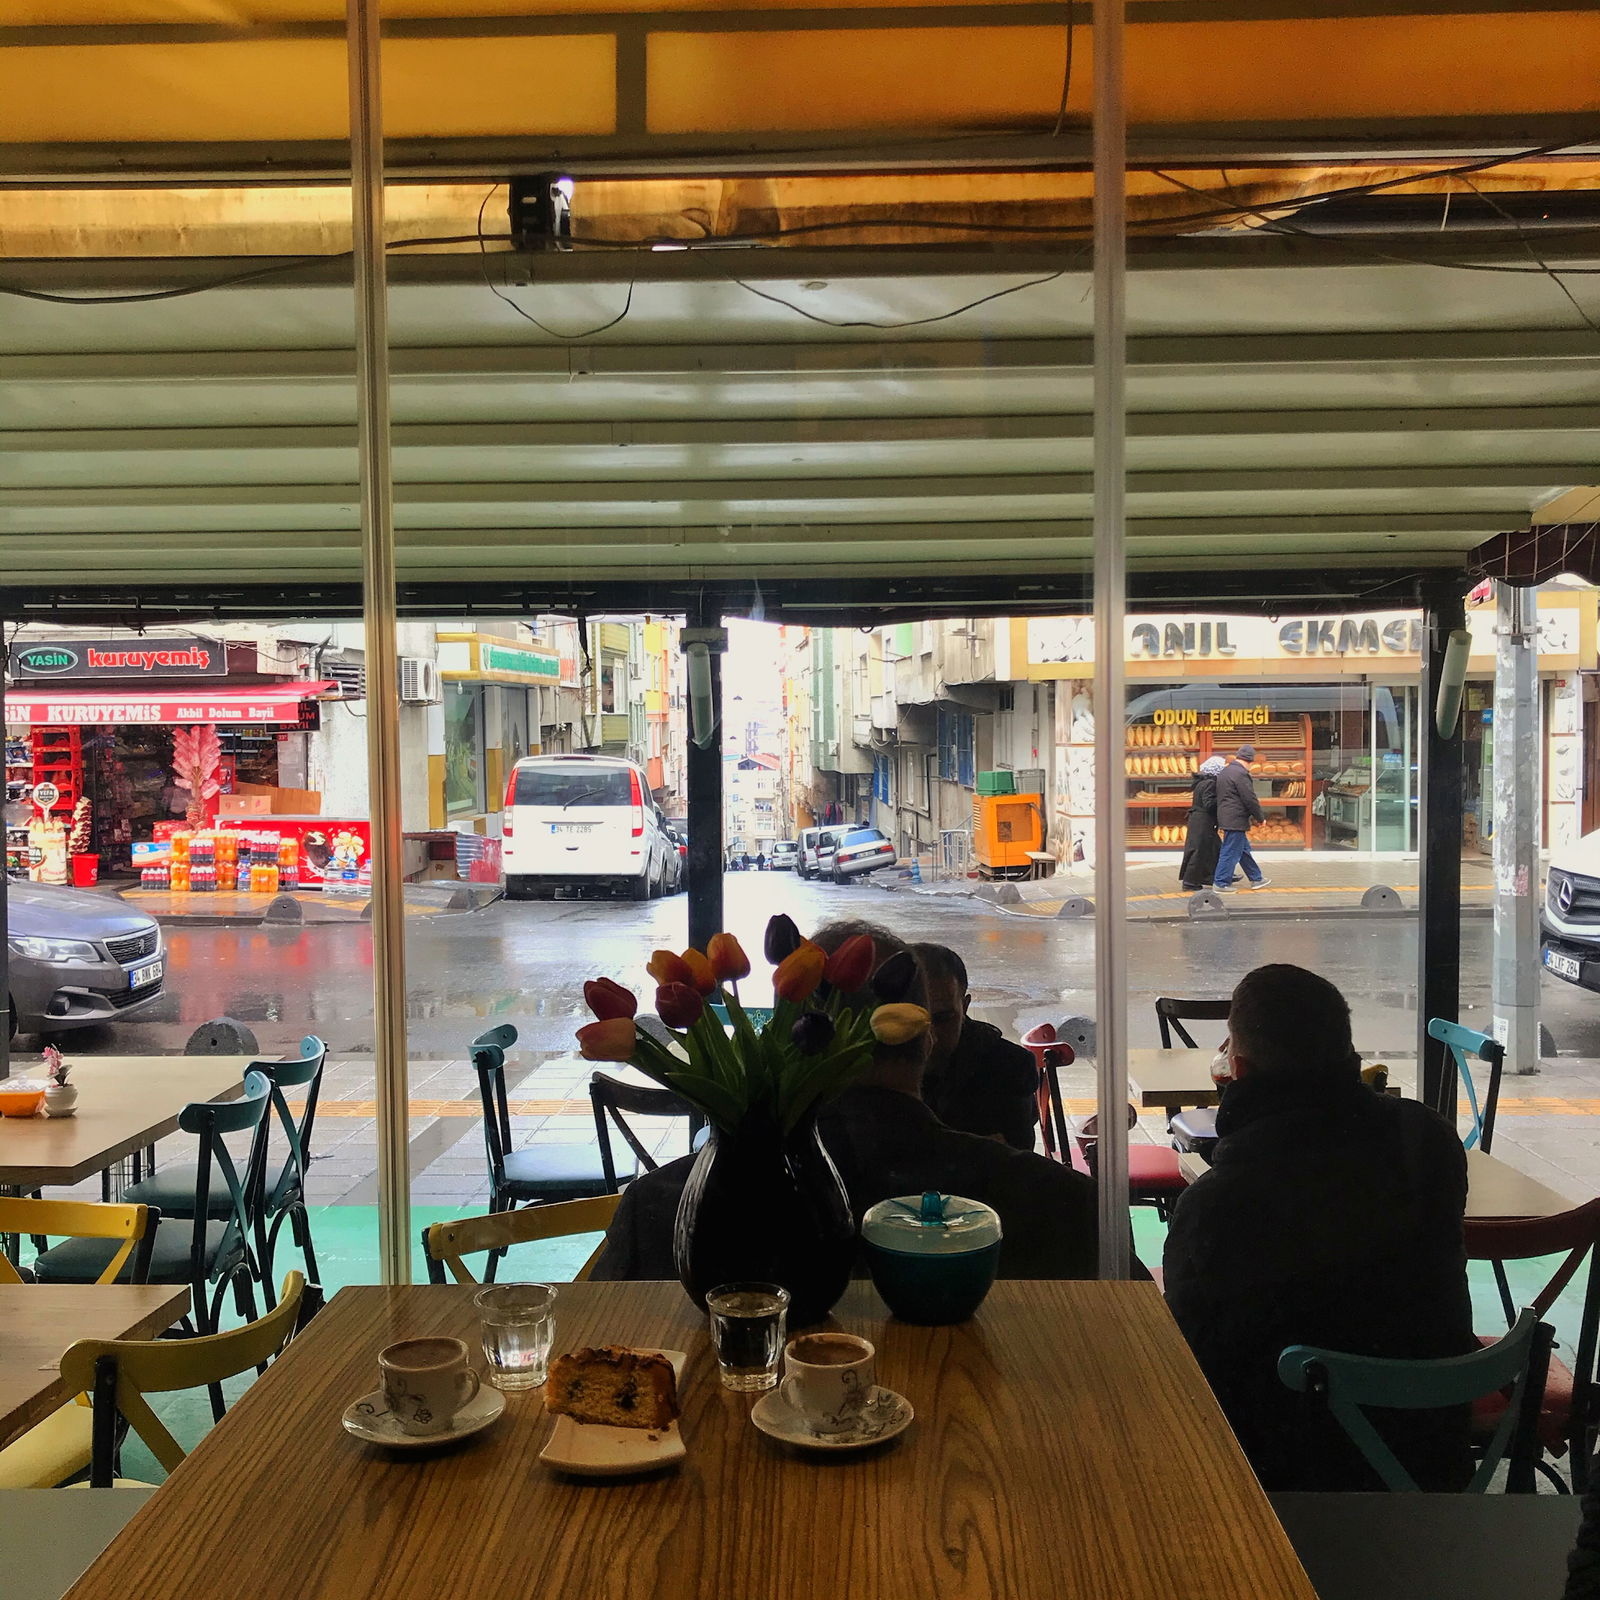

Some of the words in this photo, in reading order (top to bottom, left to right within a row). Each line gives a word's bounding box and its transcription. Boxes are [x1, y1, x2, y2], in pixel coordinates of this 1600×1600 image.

[1131, 621, 1237, 655] ANIL
[27, 652, 68, 666] YASİN
[87, 646, 210, 671] kuruyemiş
[176, 707, 203, 719] Akbil
[208, 708, 242, 719] Dolum
[248, 706, 274, 720] Bayii
[1153, 709, 1198, 726] ODUN
[1210, 705, 1269, 726] EKMEĞİ
